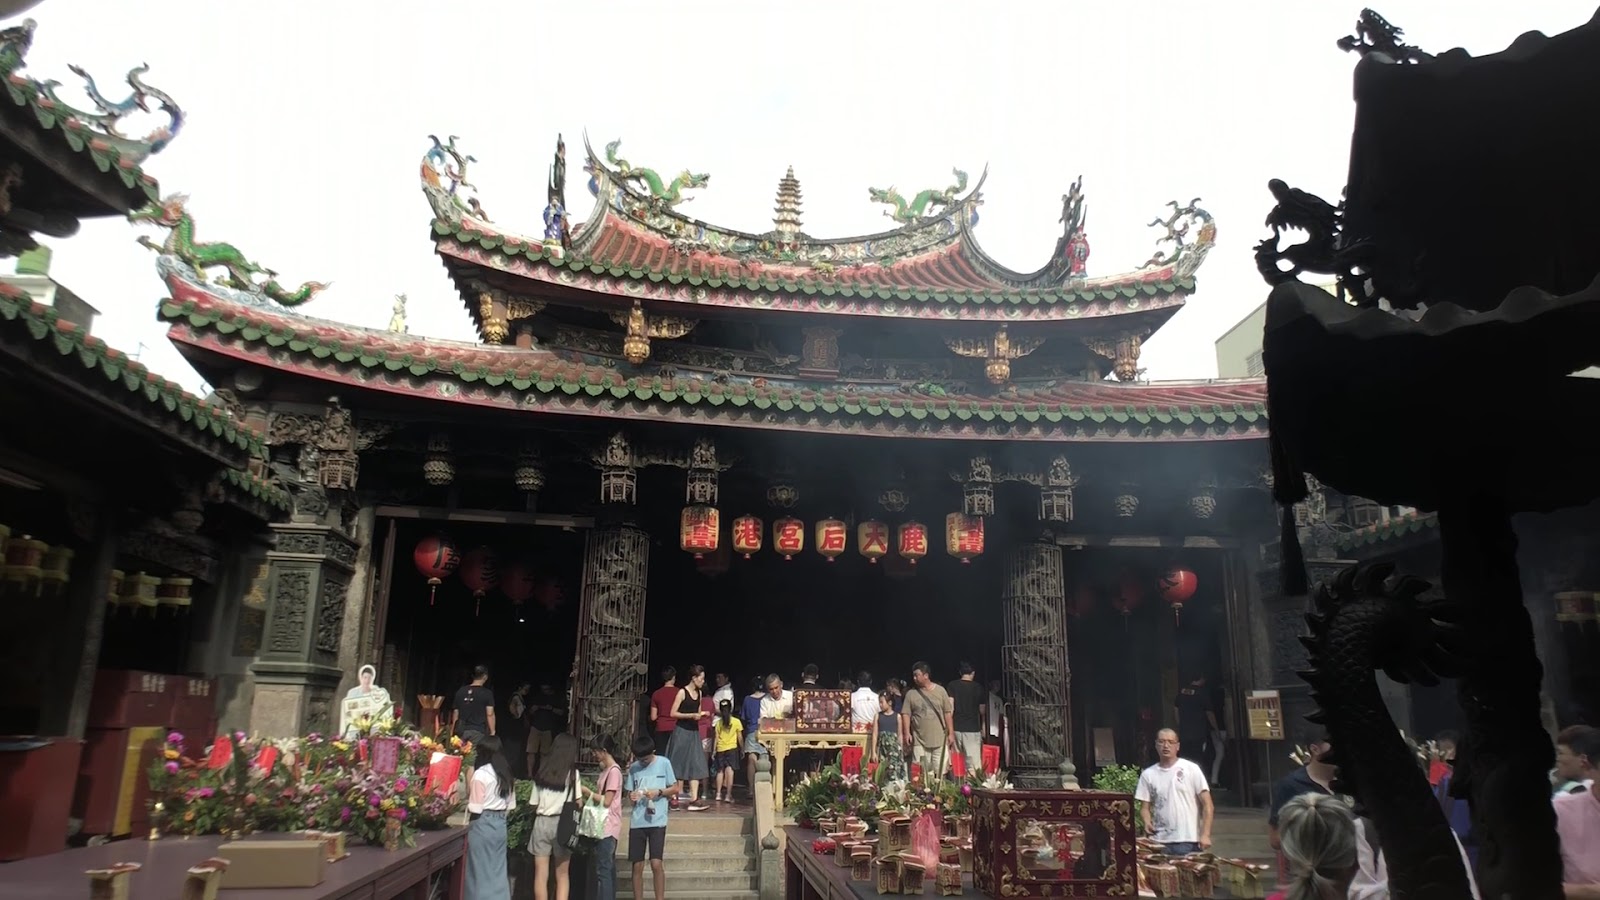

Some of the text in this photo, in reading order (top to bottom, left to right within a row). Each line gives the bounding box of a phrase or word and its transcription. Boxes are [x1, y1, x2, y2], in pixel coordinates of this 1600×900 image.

[735, 518, 761, 548] 港
[777, 522, 803, 549] 宮
[820, 522, 847, 549] 后
[900, 522, 925, 552] 鹿
